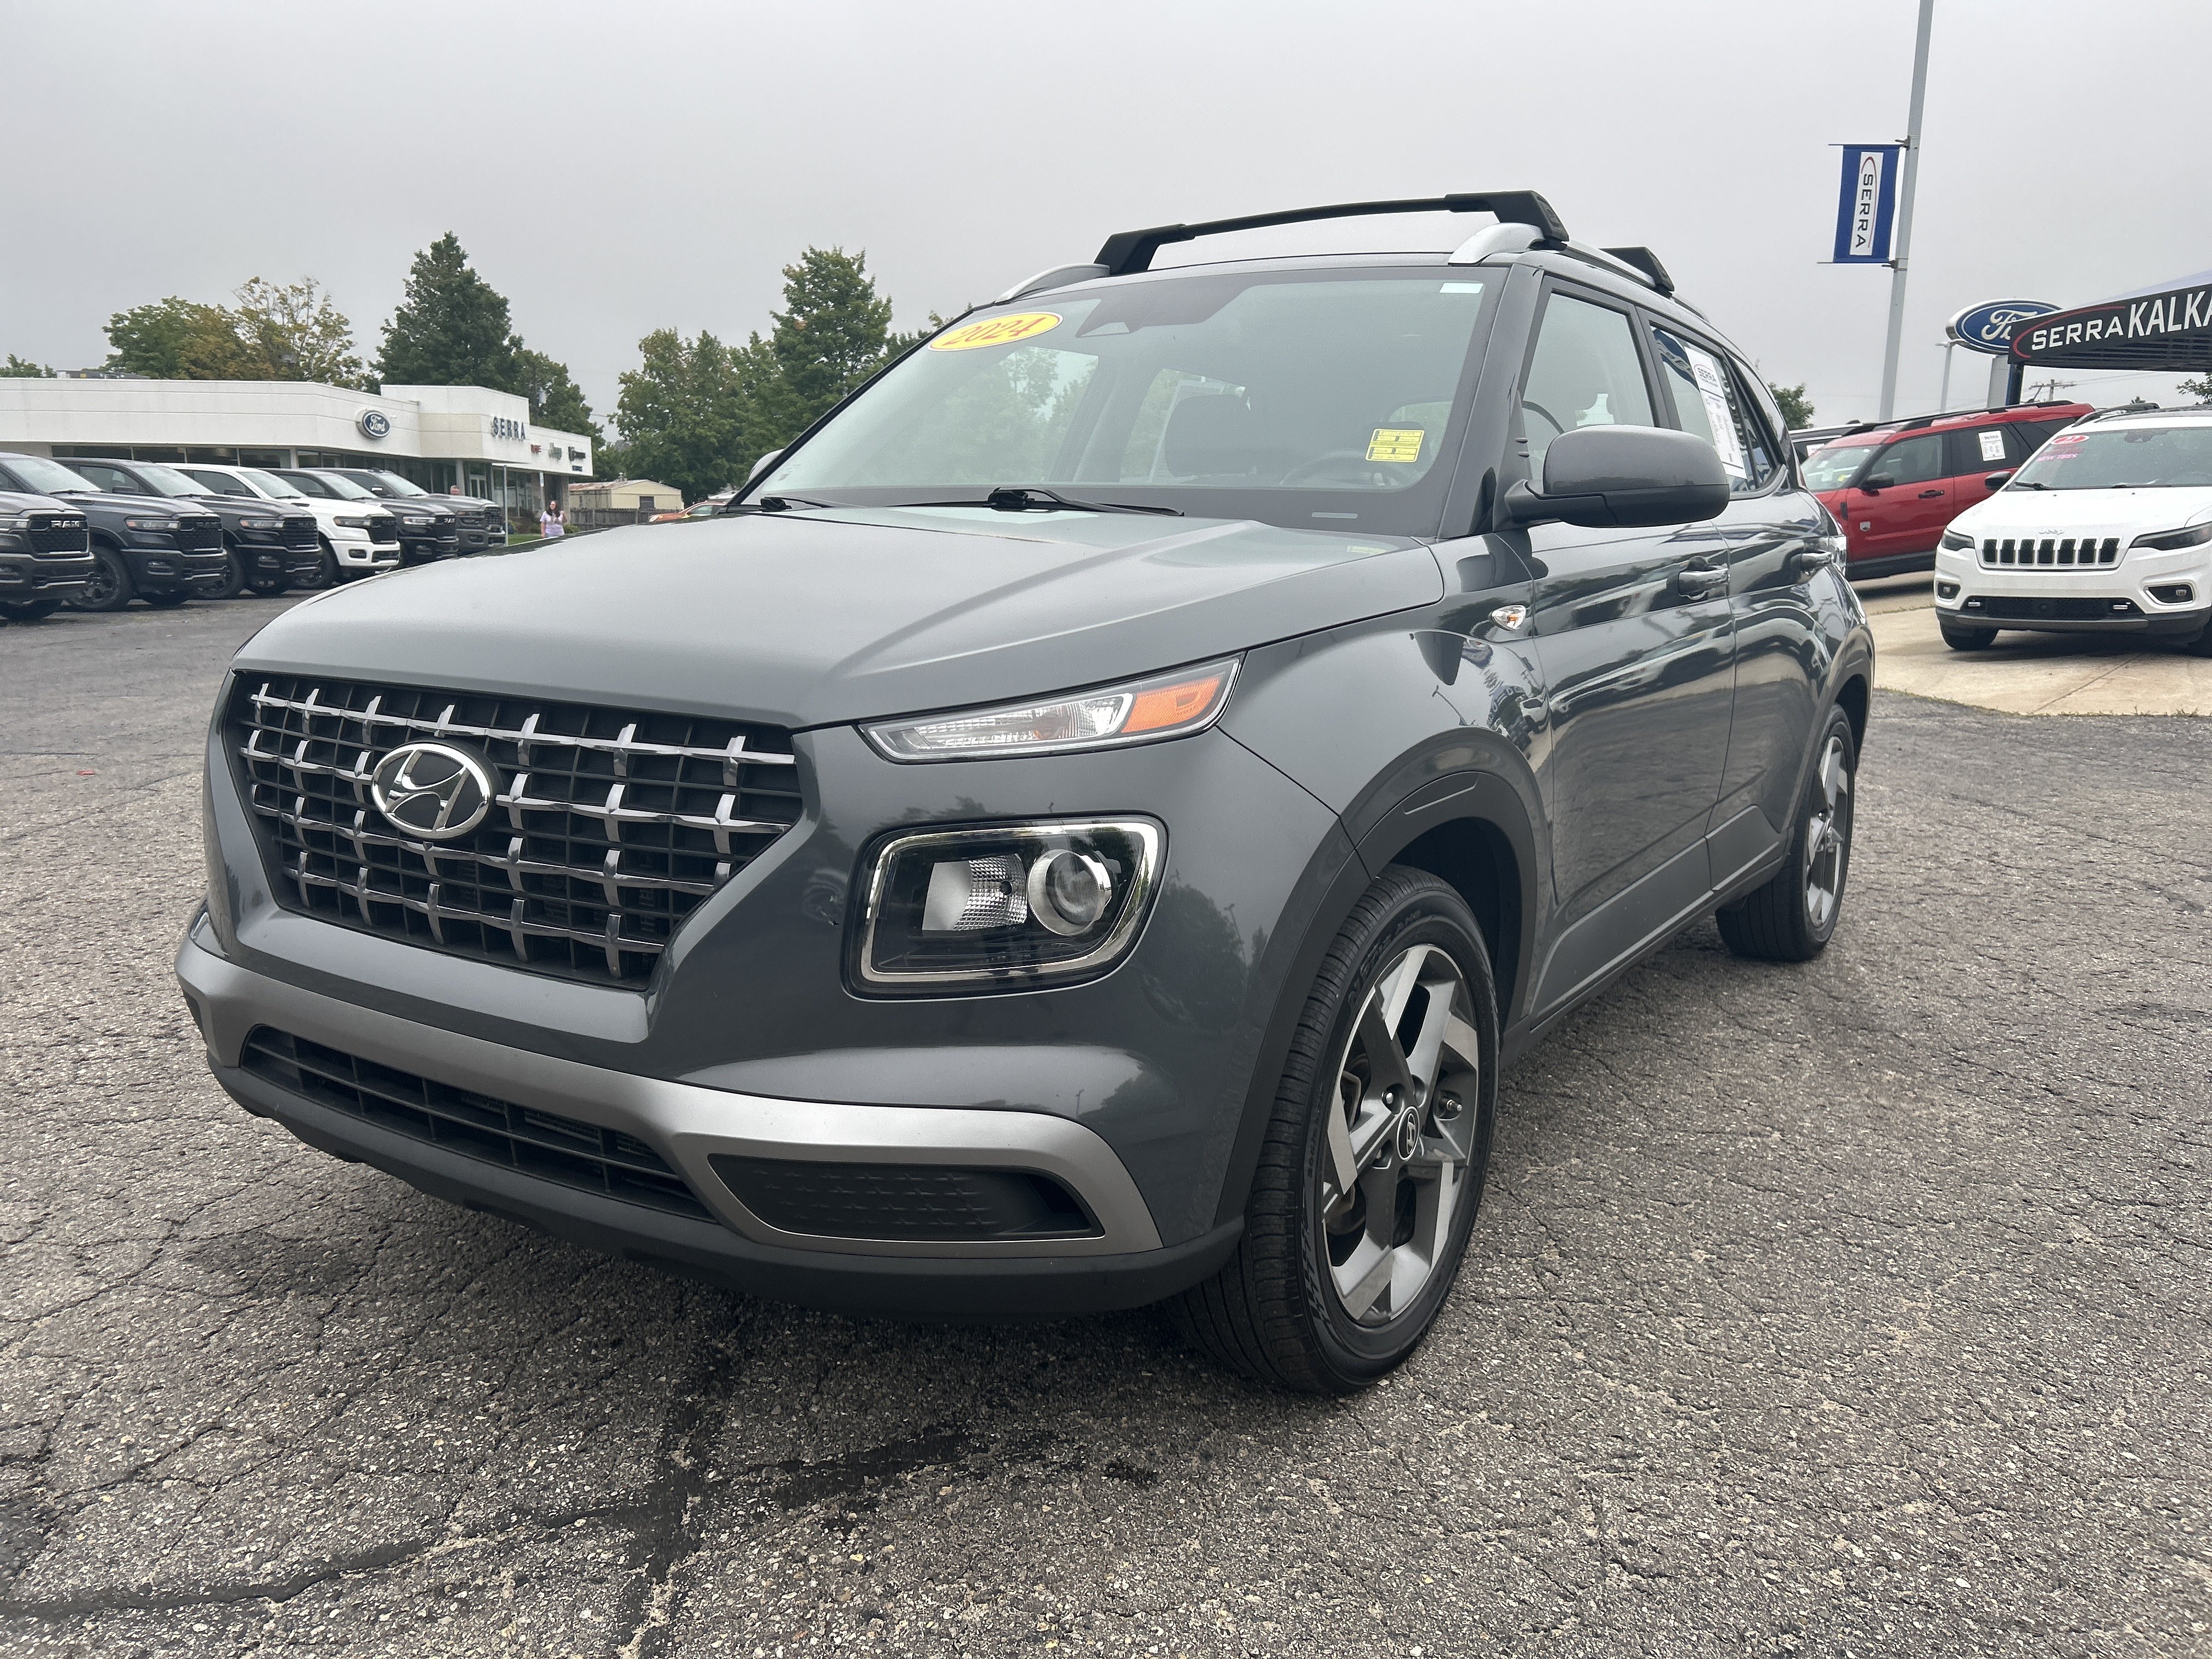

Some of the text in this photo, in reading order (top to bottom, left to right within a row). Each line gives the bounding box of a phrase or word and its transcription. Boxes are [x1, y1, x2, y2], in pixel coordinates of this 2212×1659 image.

[1855, 173, 1874, 248] SERRA
[941, 317, 1048, 346] 2024
[2031, 315, 2124, 351] SERRA
[369, 414, 386, 432] Ford
[492, 416, 526, 440] SERRA
